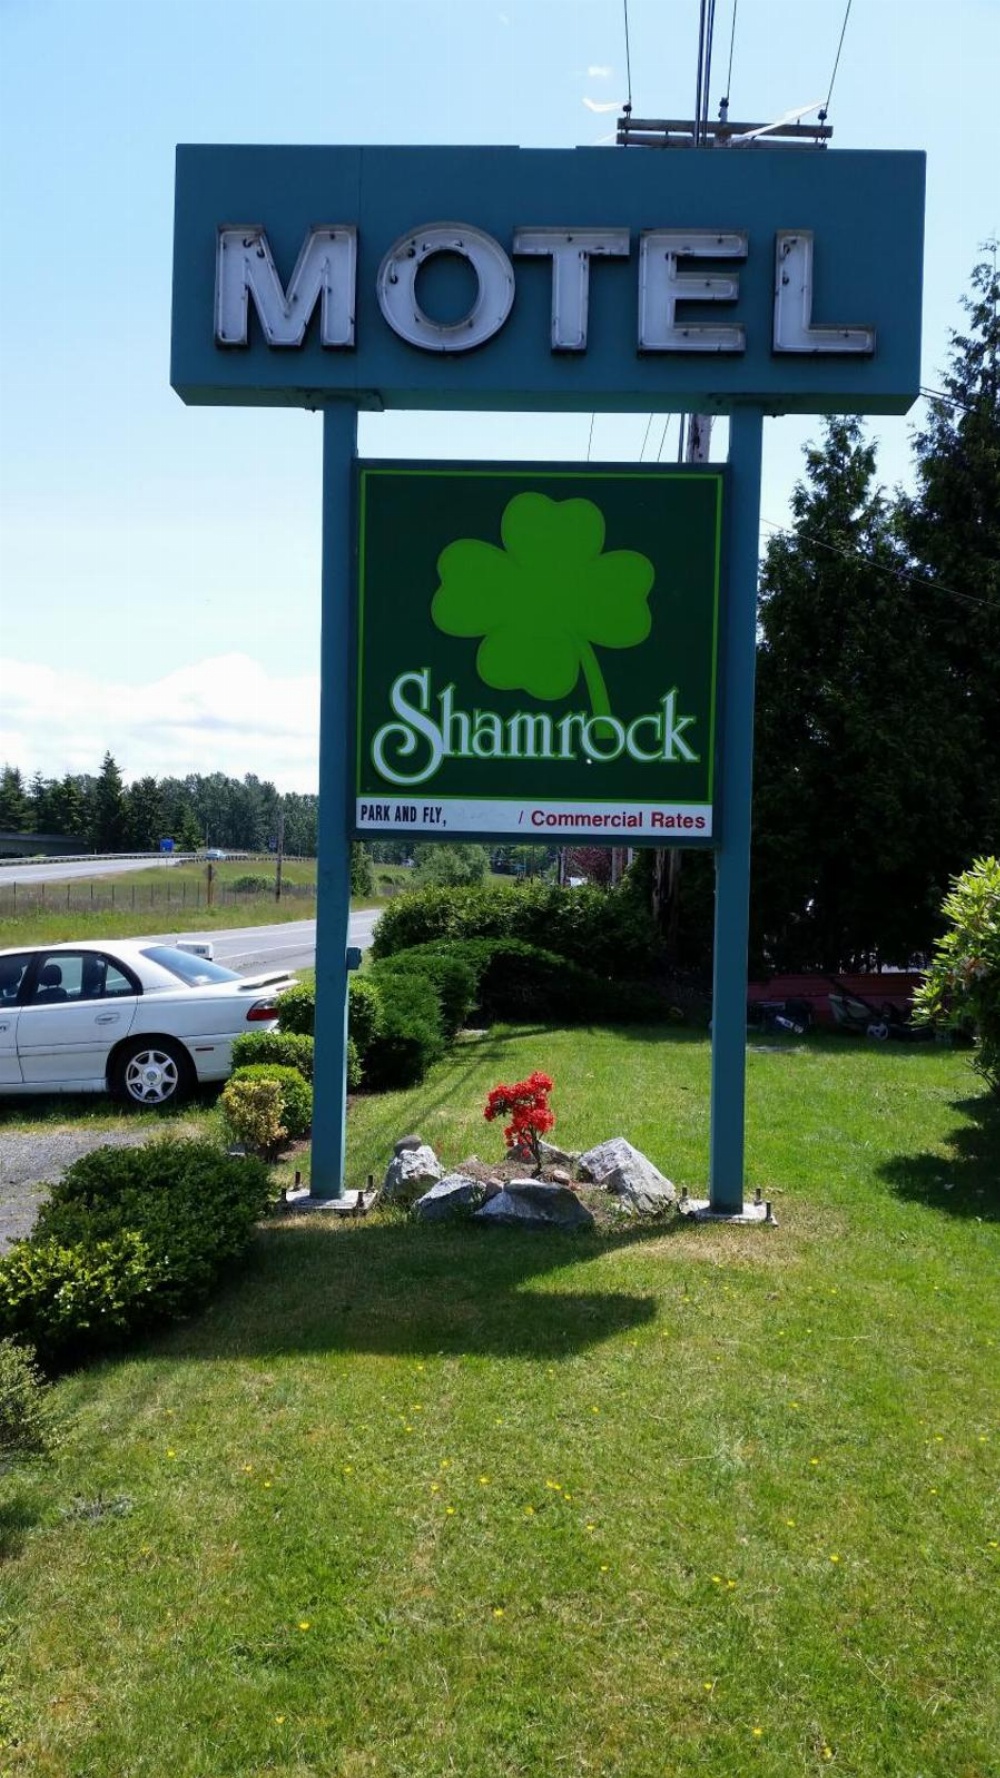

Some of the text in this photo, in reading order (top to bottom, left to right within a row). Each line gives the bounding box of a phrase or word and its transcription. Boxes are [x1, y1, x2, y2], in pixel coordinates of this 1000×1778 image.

[214, 222, 877, 354] MOTEL
[372, 667, 700, 786] Shamrock
[360, 805, 390, 822] PARK
[395, 806, 416, 823] AND
[531, 811, 643, 828] Commercial
[650, 812, 706, 829] Rates
